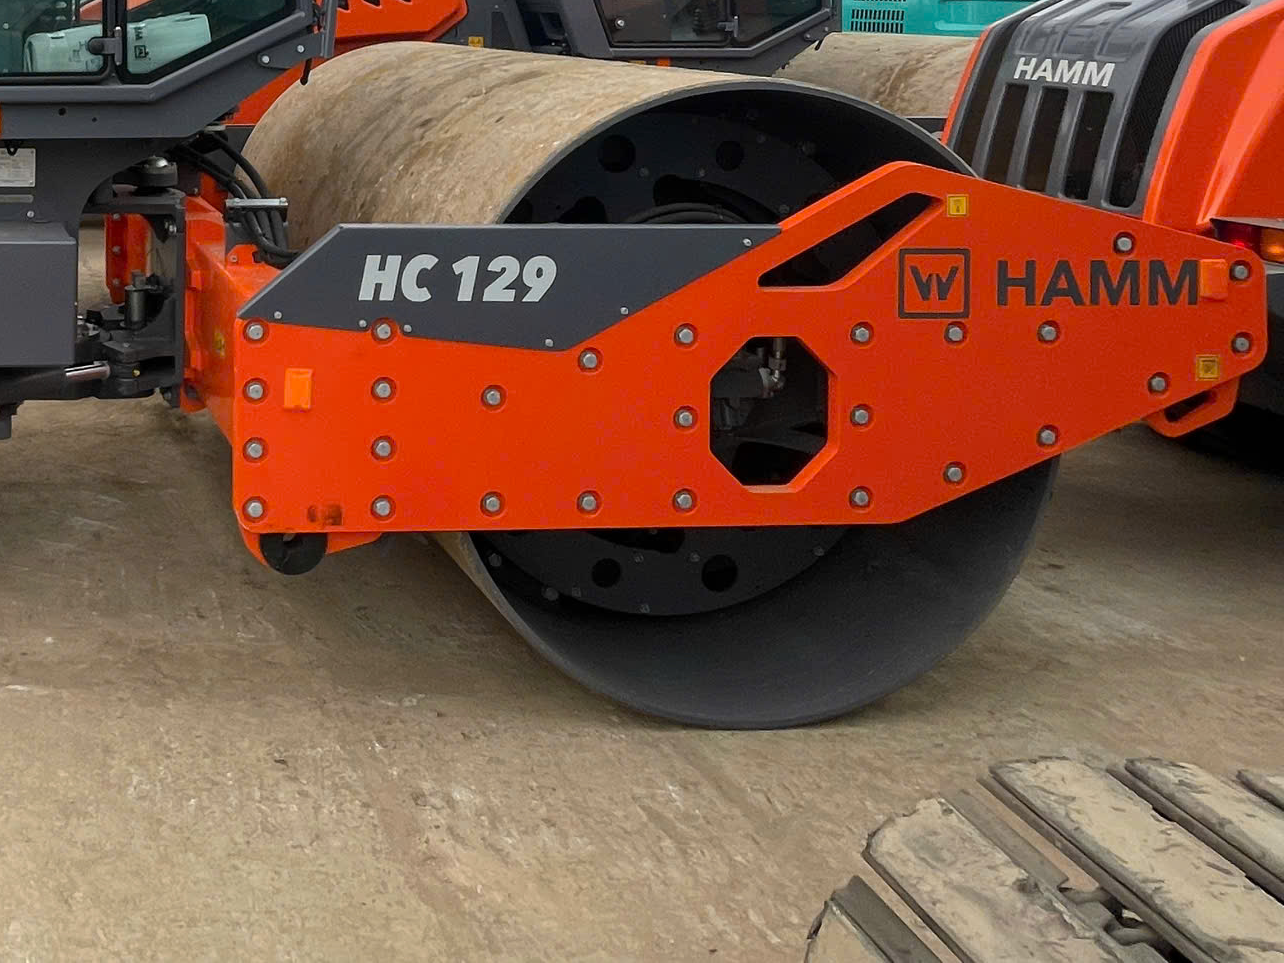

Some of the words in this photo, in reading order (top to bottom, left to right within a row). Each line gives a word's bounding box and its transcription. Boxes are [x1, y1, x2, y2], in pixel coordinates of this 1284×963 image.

[1014, 57, 1116, 87] HAMM
[358, 254, 439, 302] HC
[452, 255, 557, 302] 129
[997, 259, 1199, 306] HAMM
